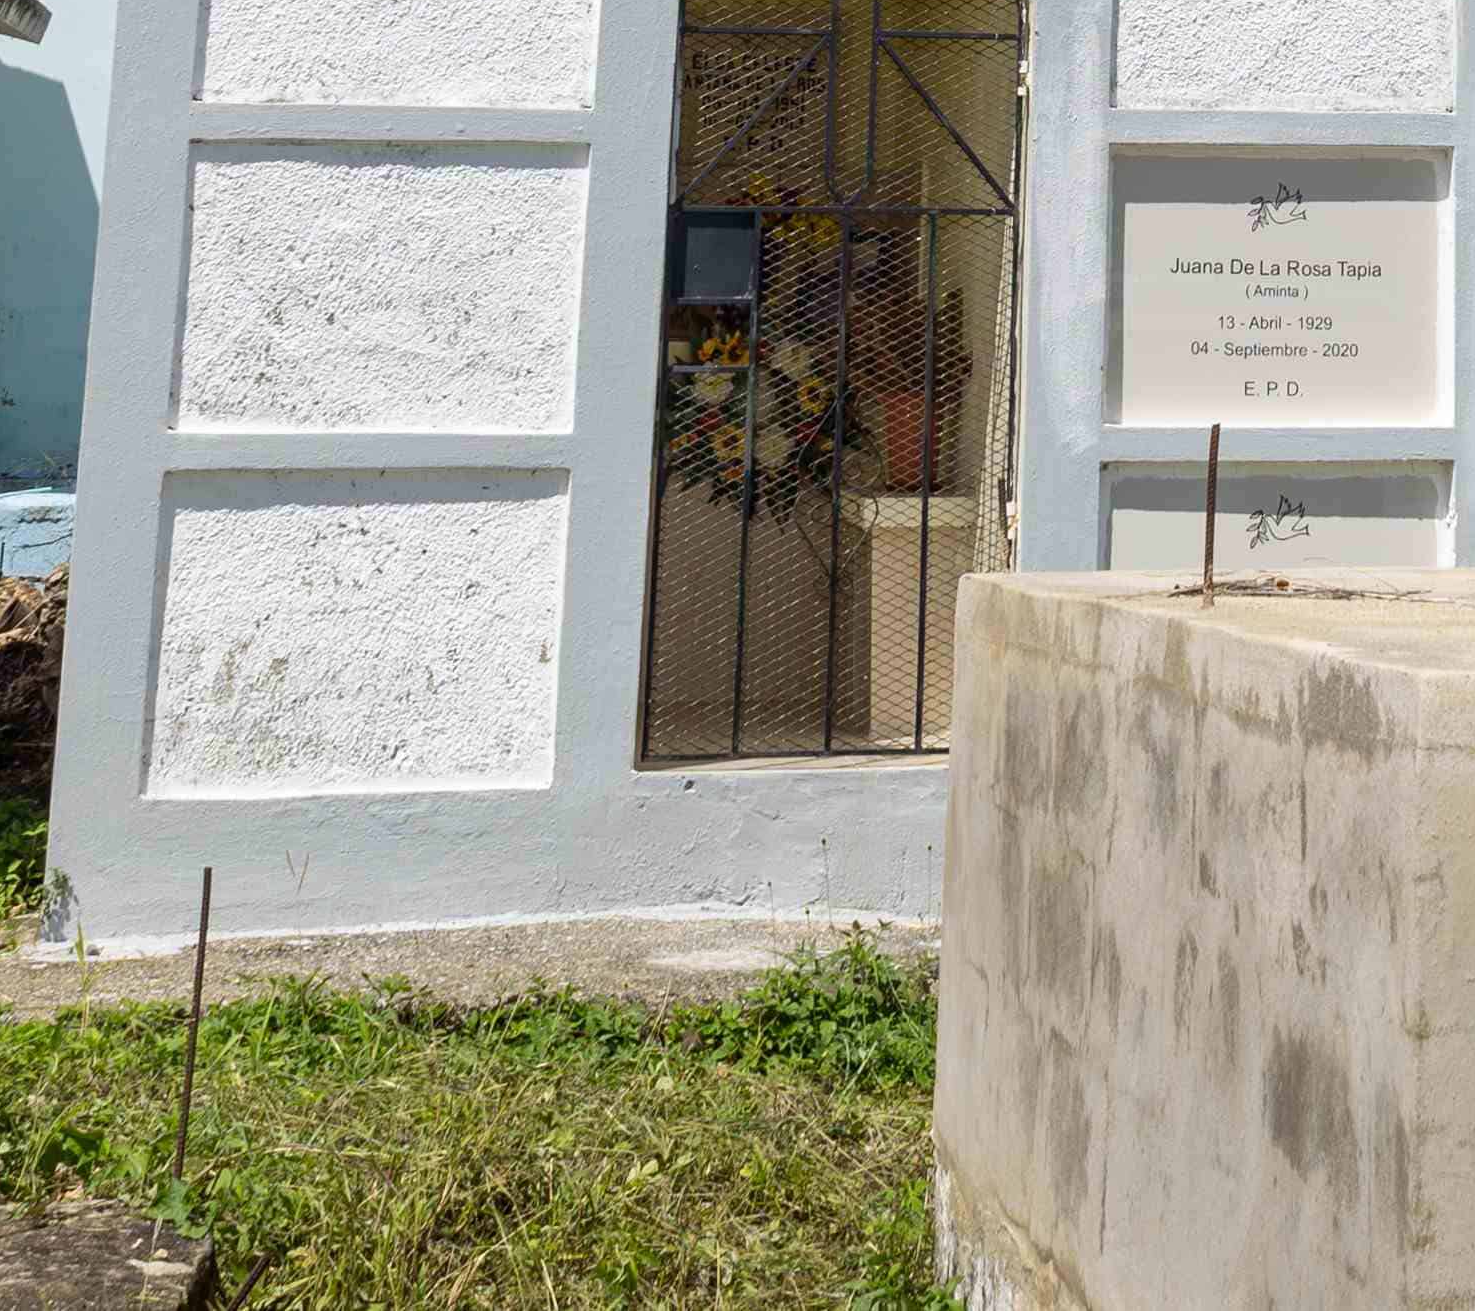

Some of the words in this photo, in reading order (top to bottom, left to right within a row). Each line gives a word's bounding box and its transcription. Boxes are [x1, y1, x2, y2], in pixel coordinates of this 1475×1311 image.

[1170, 258, 1223, 275] Juana
[1230, 259, 1254, 276] De
[1259, 260, 1281, 276] La
[1287, 260, 1332, 277] Rosa
[1337, 261, 1382, 281] Tapia
[1218, 317, 1235, 329] 13
[1249, 316, 1282, 330] Abril
[1298, 317, 1333, 330] 1929
[1191, 341, 1209, 356] 04
[1224, 342, 1308, 359] Septiembre
[1323, 344, 1359, 358] 2020
